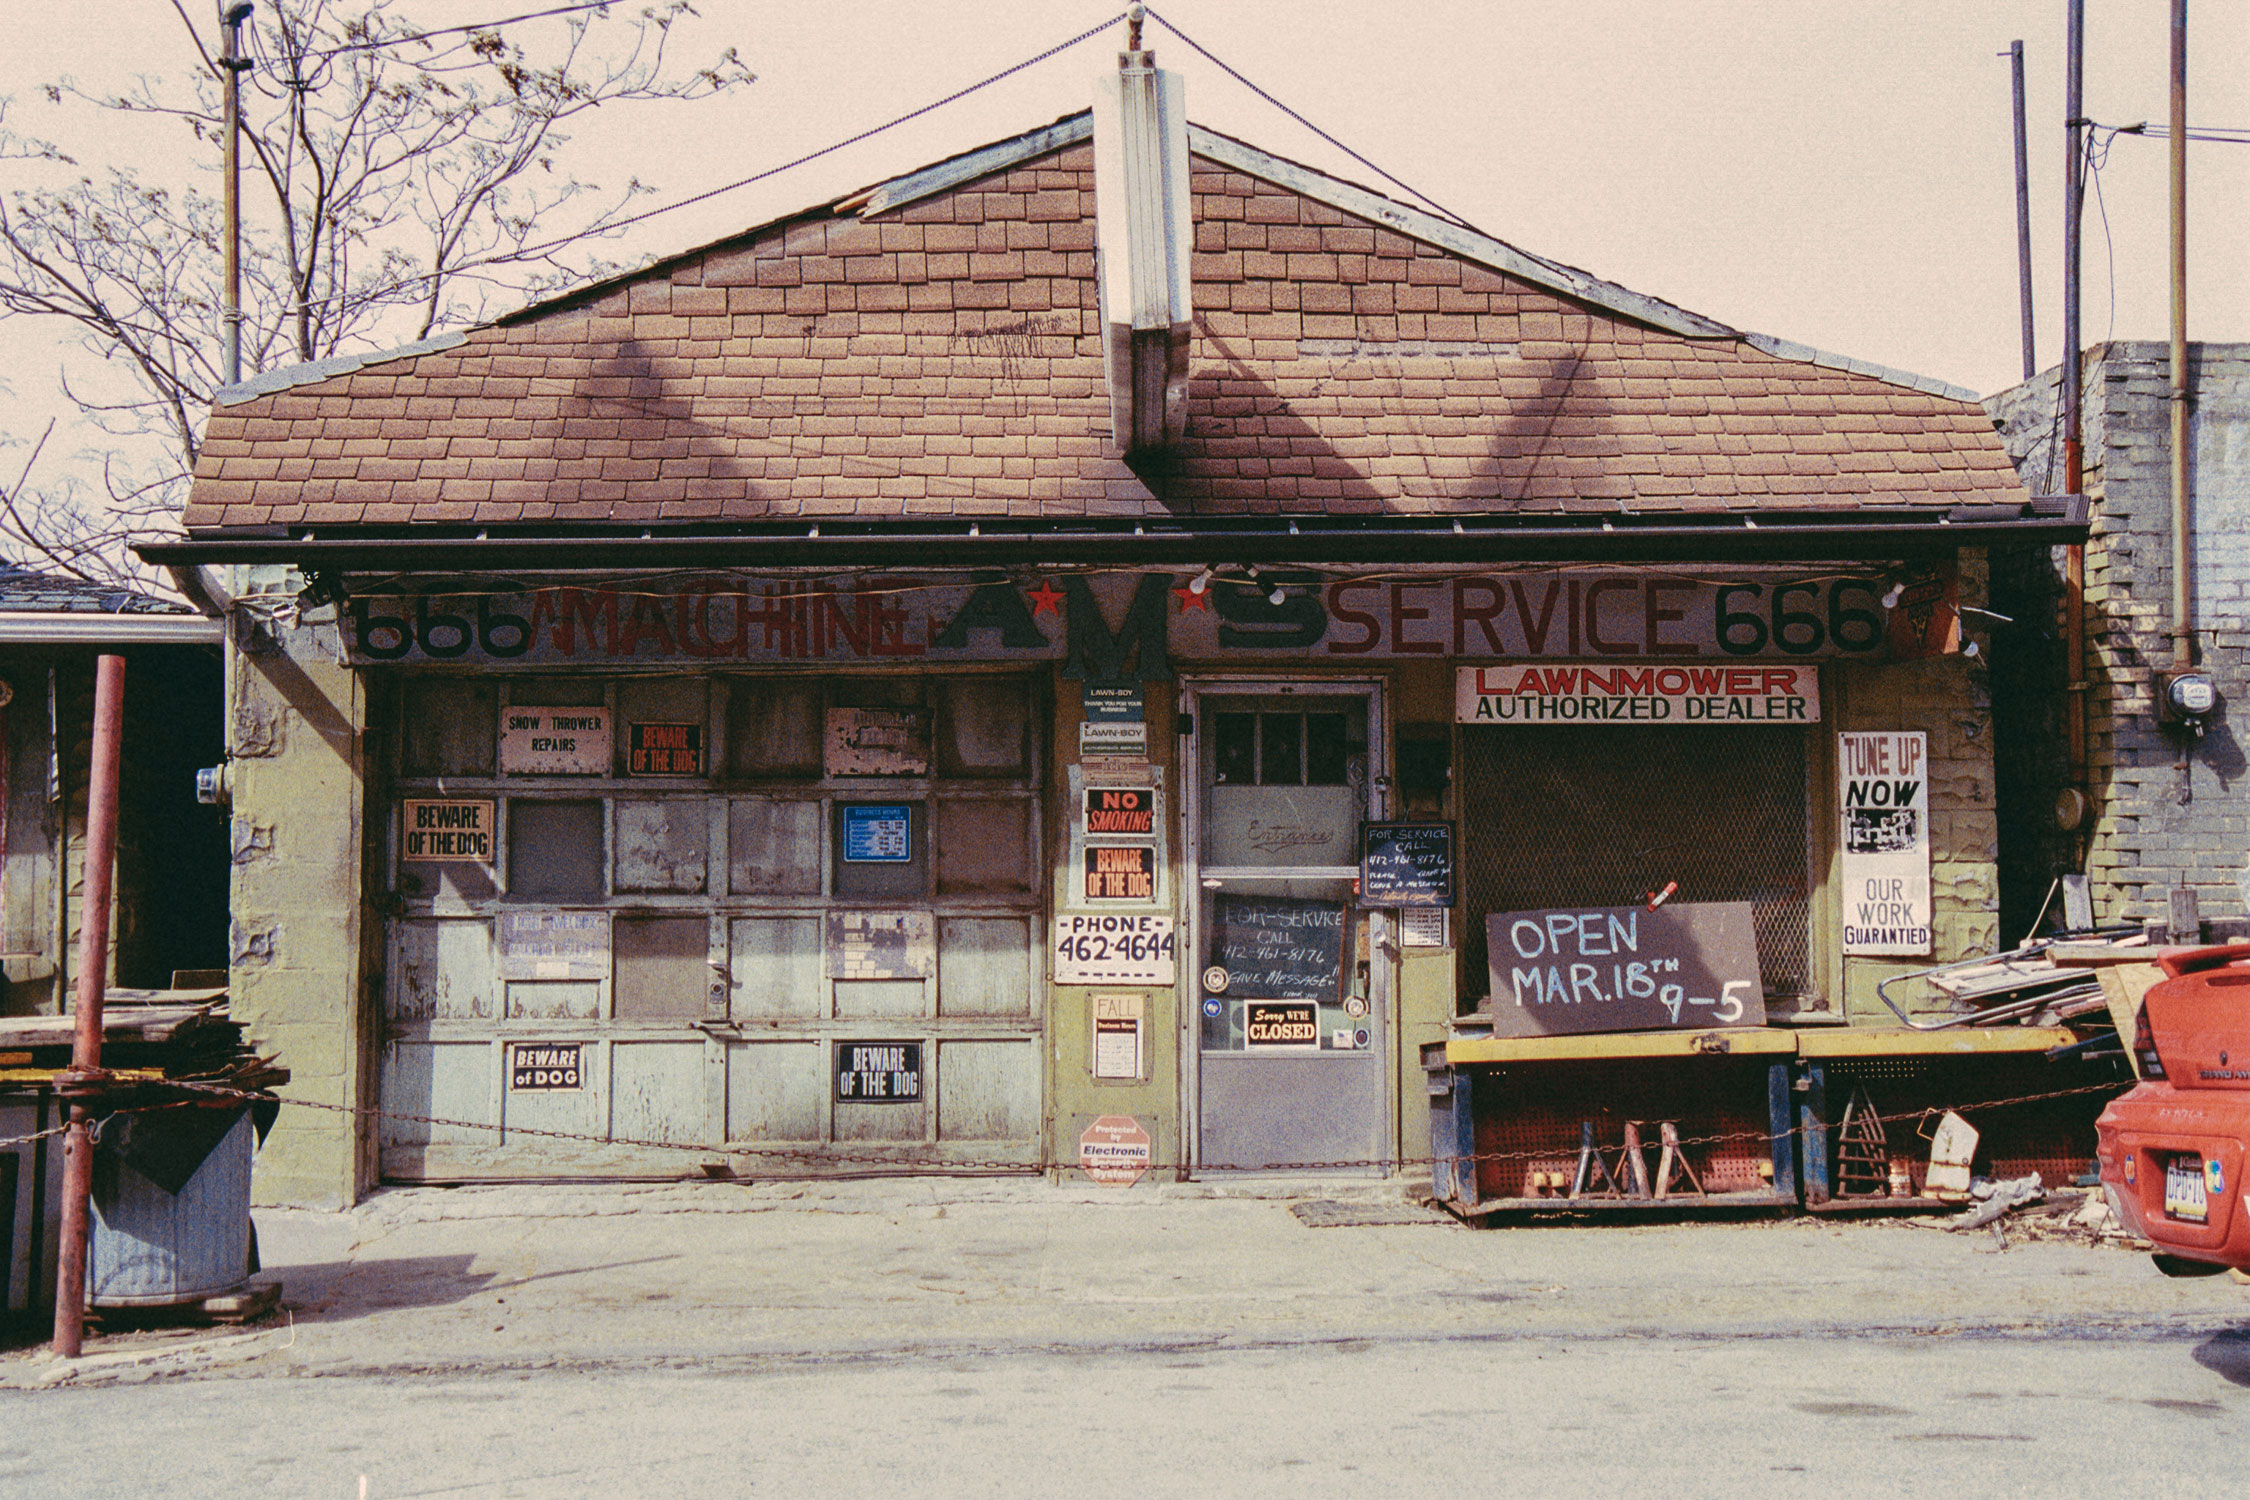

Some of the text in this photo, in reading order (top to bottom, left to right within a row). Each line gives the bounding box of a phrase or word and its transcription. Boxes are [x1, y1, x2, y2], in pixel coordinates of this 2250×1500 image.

[1328, 577, 1701, 656] SERVICE
[1714, 578, 1884, 656] 666
[1475, 668, 1799, 696] LAWNMOWER
[1090, 689, 1134, 697] LAWN-BOY
[1475, 696, 1807, 721] AUTHORIZED DEALER
[508, 716, 602, 731] SNOW THROWER
[1084, 729, 1143, 737] LAWN-BOY
[531, 738, 576, 752] REPAIRS
[642, 726, 689, 750] BEWARE
[633, 749, 697, 773] OF THE DOG
[1844, 736, 1921, 777] TUNE UP
[1102, 792, 1139, 809] NO
[1845, 780, 1921, 807] NOW
[416, 805, 481, 829] BEWARE
[1088, 810, 1152, 832] SMOKING
[407, 831, 488, 855] OF THE DOG
[1368, 828, 1449, 841] FOR SERVICE
[1395, 841, 1431, 853] CALL
[1096, 849, 1142, 872] BEWARE
[1087, 872, 1151, 897] OF THE DOG
[1865, 877, 1904, 901] OUR
[1856, 902, 1916, 926] WORK
[1256, 930, 1294, 945] CALL
[1510, 911, 1638, 959] OPEN
[1844, 925, 1928, 945] GUARANTIED
[1097, 998, 1136, 1017] FALL
[1659, 980, 1752, 1024] 9-5
[1254, 1009, 1310, 1024] Sorry WE'RE
[1249, 1023, 1315, 1040] CLOSED
[515, 1049, 578, 1067] BEWARE
[852, 1047, 906, 1071] BEWARE
[515, 1070, 578, 1086] of DOG
[840, 1072, 919, 1097] OF THE DOG
[1095, 1125, 1137, 1134] Protected
[1110, 1133, 1122, 1142] by
[1083, 1145, 1147, 1156] Electronic
[1092, 1167, 1135, 1180] System
